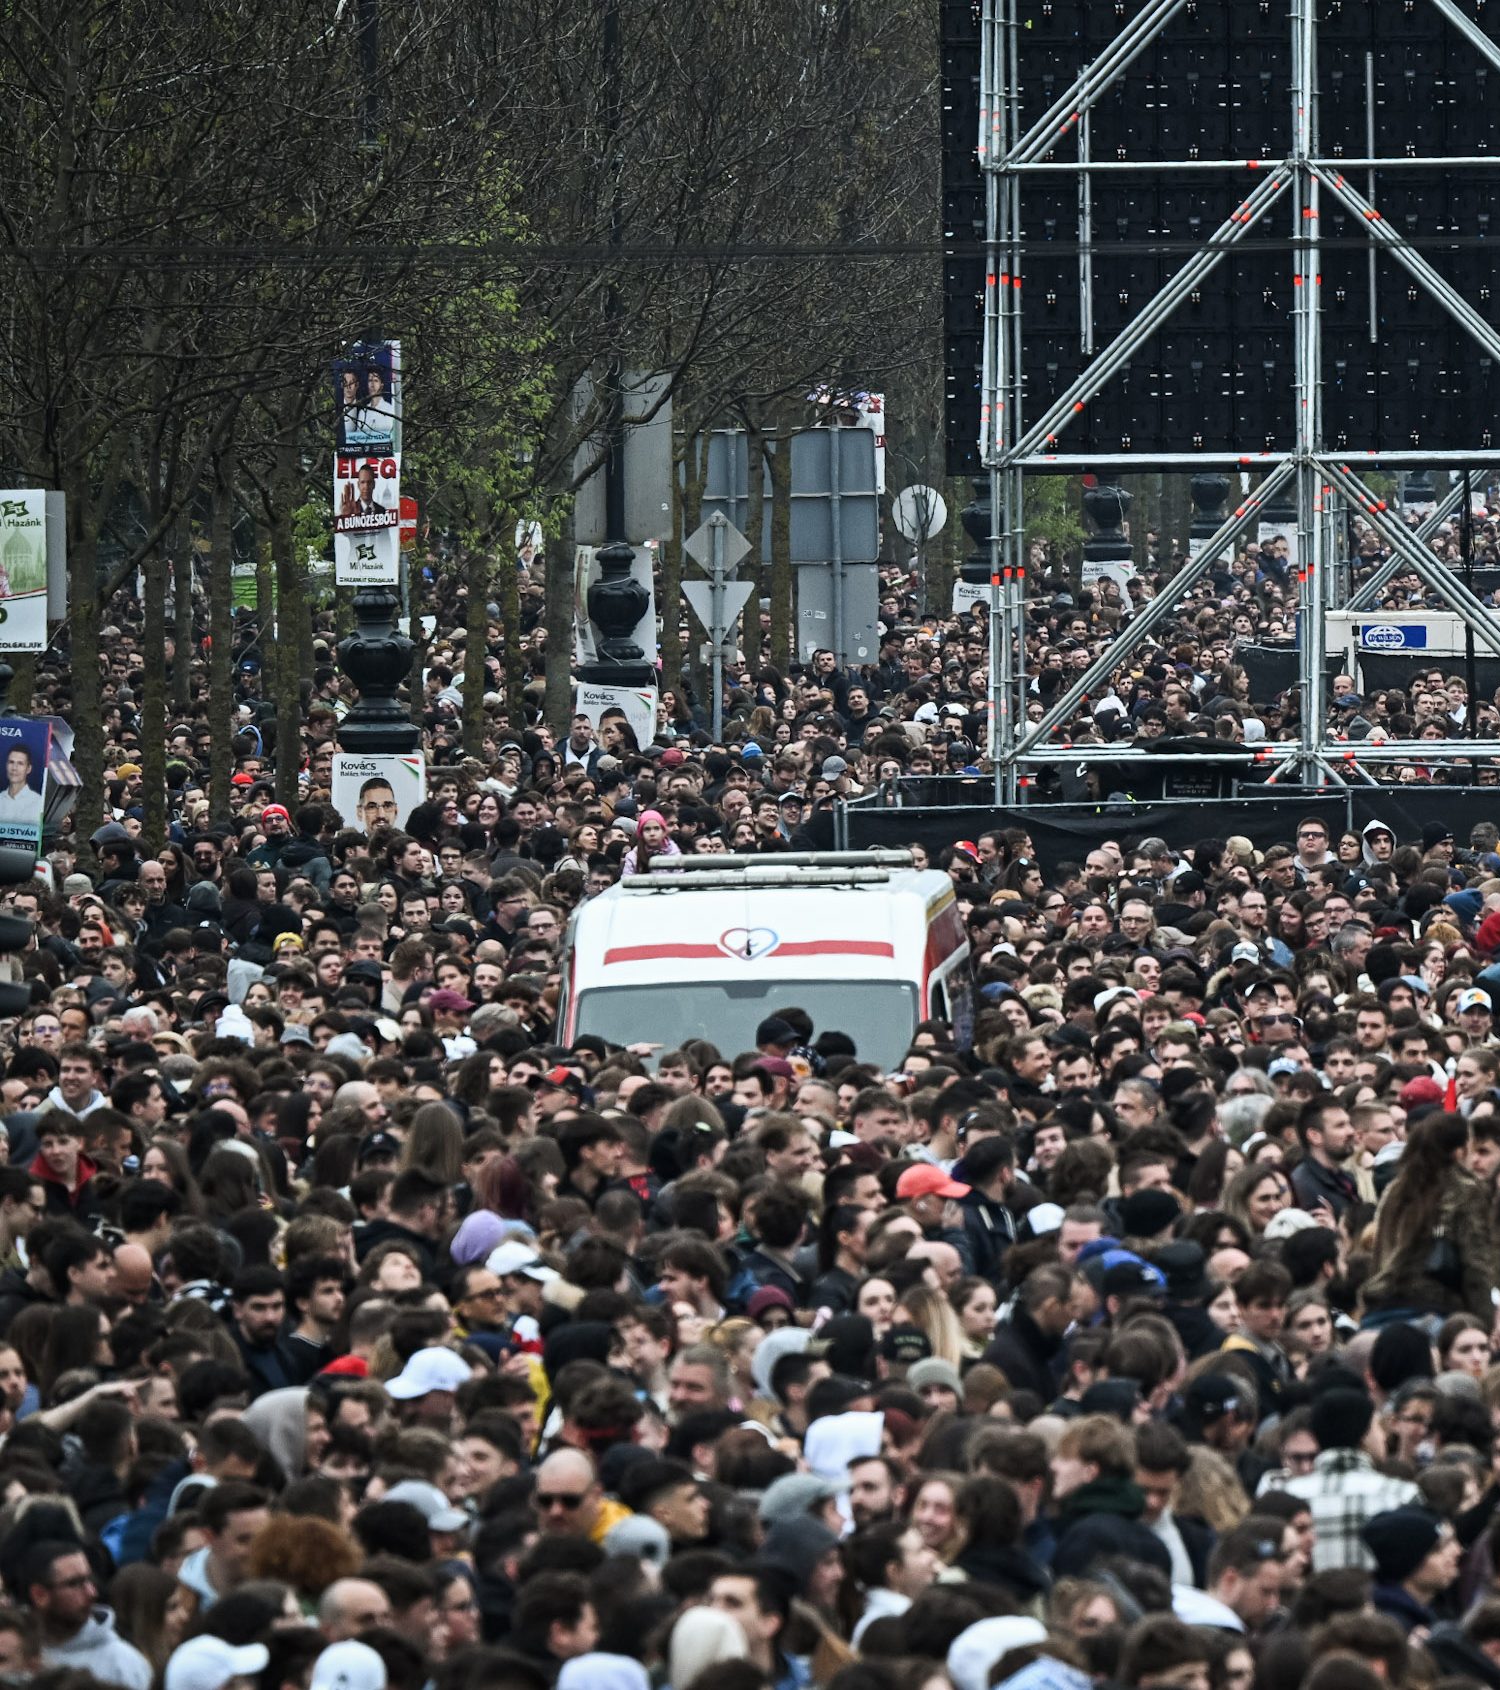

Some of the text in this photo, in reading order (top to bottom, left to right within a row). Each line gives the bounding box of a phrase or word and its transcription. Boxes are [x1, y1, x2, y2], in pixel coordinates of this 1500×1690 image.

[7, 517, 42, 528] Hazánk
[337, 511, 397, 530] A BŰNÖZÉSBŐL!
[350, 562, 358, 570] Mi
[583, 690, 615, 701] Kovács
[0, 727, 23, 738] ISZA
[340, 760, 377, 771] Kovács
[7, 826, 37, 838] ISTVÁN
